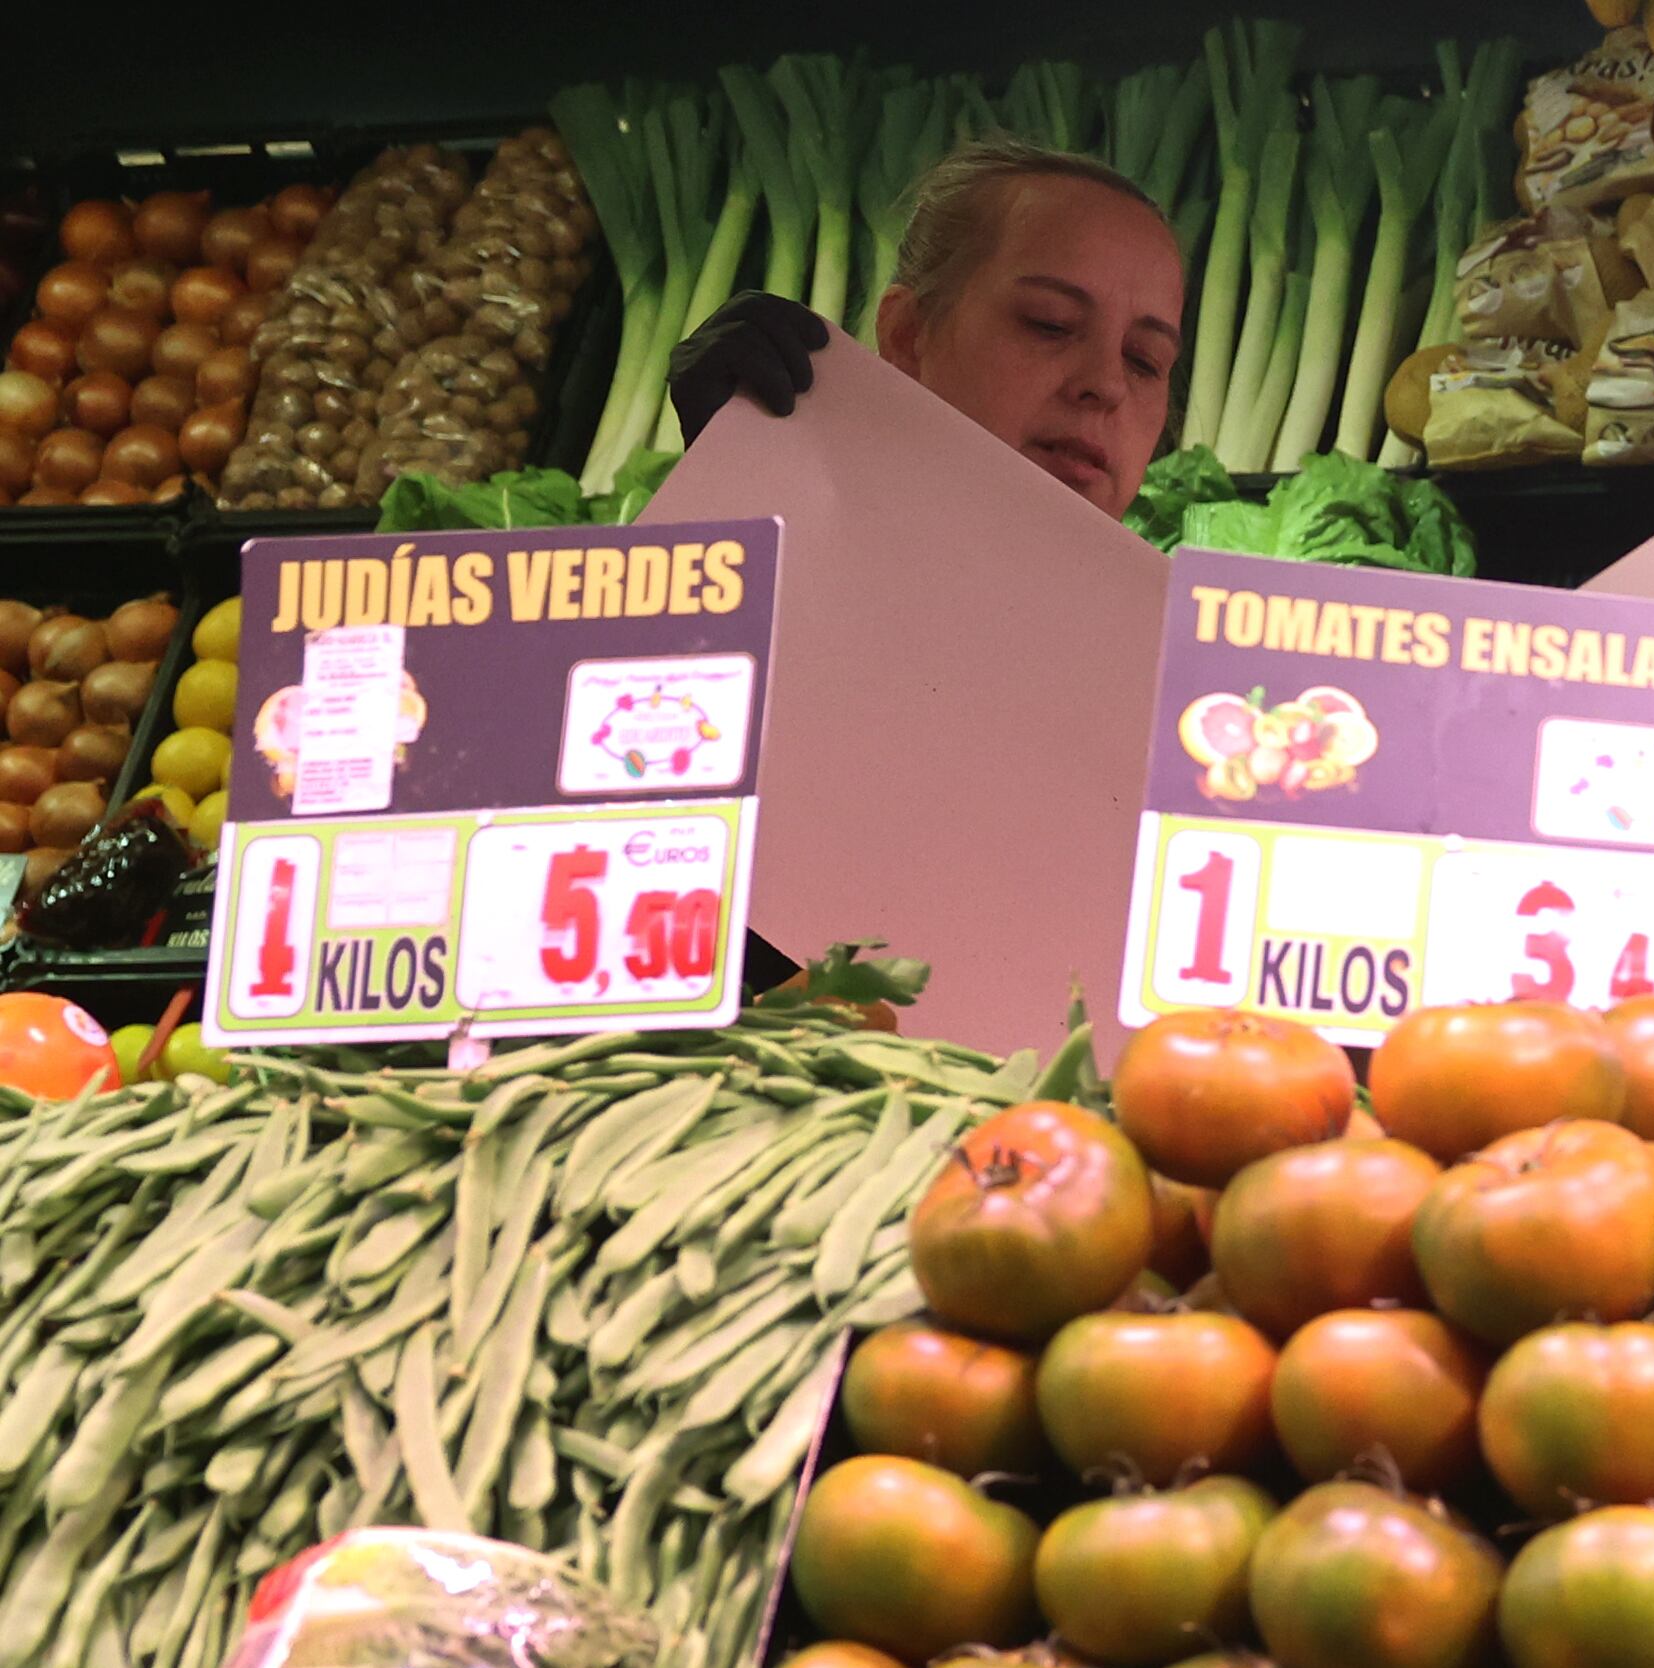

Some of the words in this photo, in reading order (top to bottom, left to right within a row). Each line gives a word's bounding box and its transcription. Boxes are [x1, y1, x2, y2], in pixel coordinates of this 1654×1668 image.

[270, 543, 494, 633] JUDÍAS
[508, 540, 745, 622] VERDES
[1190, 586, 1450, 668] TOMATES
[249, 857, 297, 998] 1
[313, 935, 448, 1012] KILOS
[1179, 851, 1234, 985] 1
[1258, 938, 1412, 1019] KILOS
